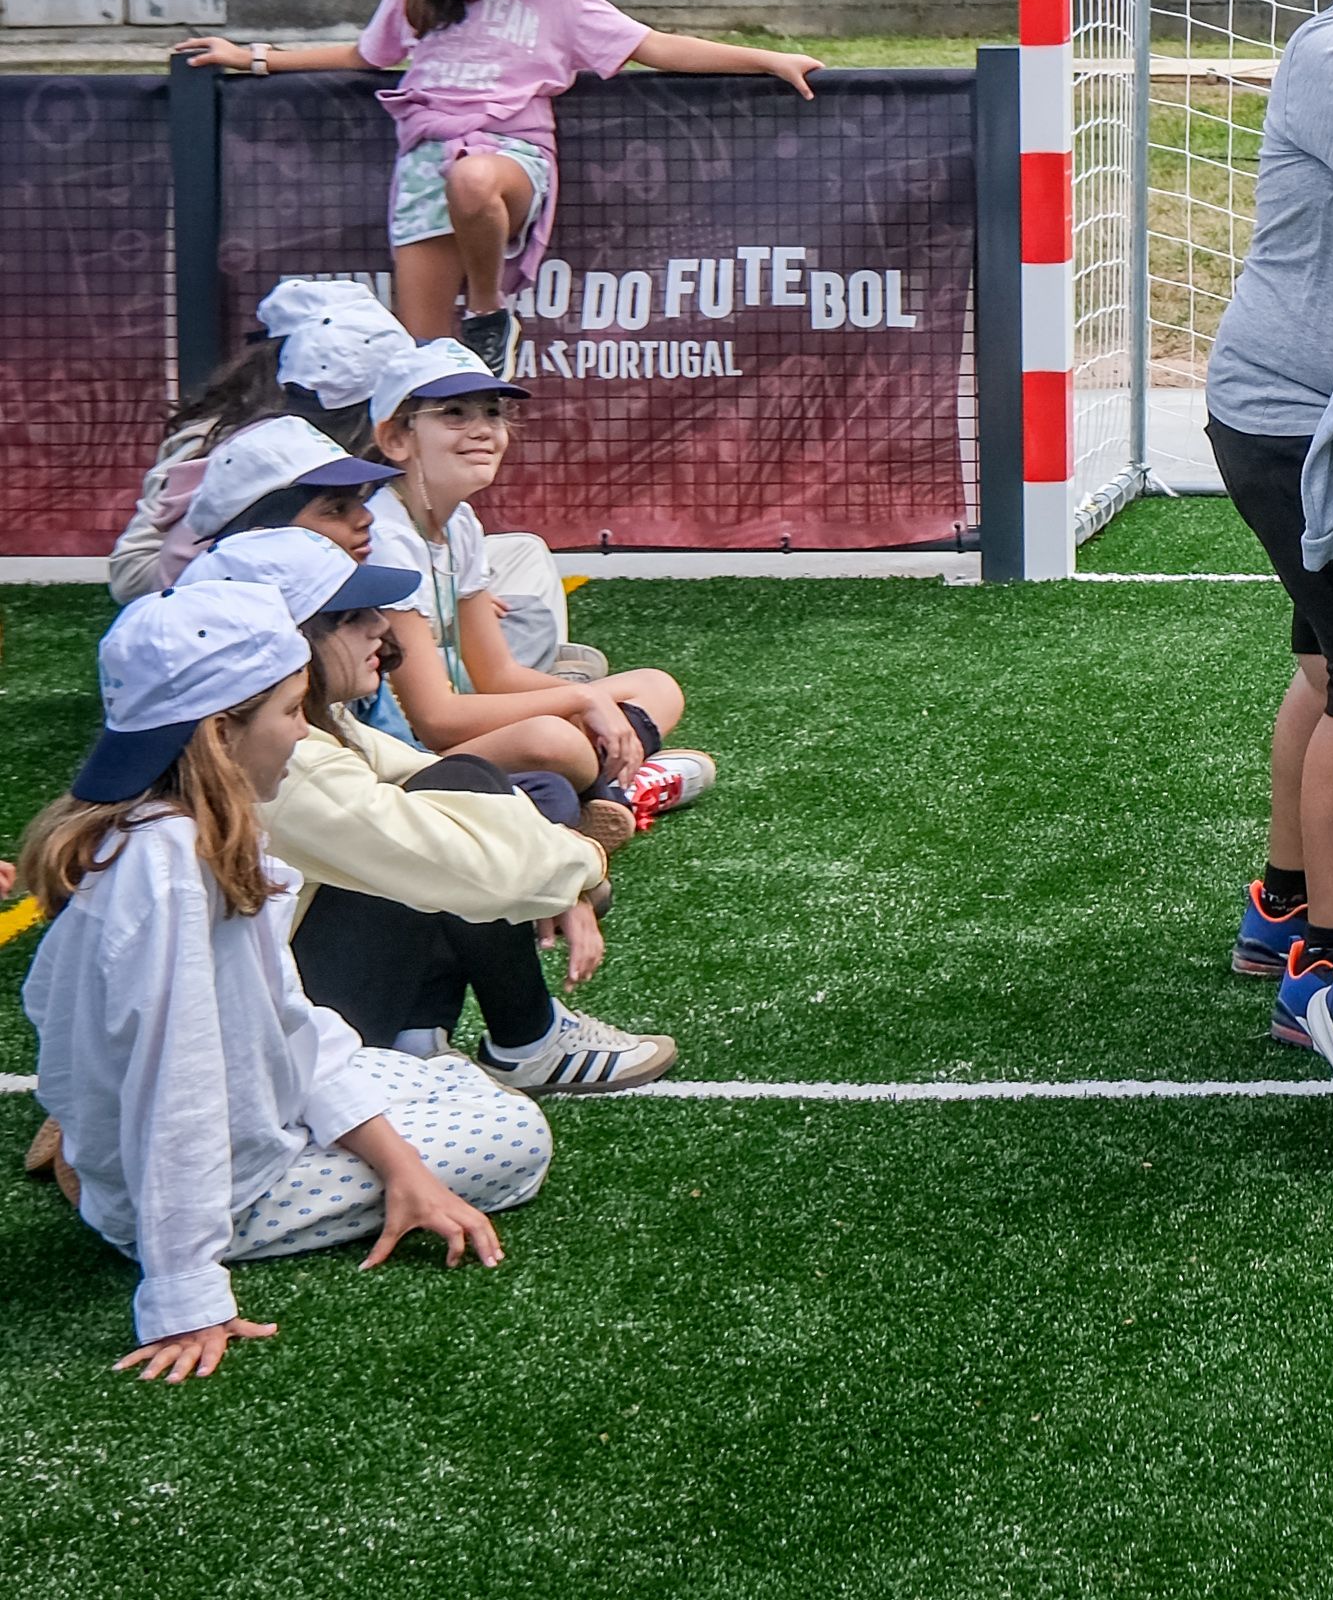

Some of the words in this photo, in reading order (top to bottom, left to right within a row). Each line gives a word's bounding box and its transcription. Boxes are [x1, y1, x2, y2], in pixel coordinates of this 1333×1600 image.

[581, 271, 653, 331] DO
[665, 246, 918, 330] FUTEBOL
[577, 339, 744, 379] PORTUGAL
